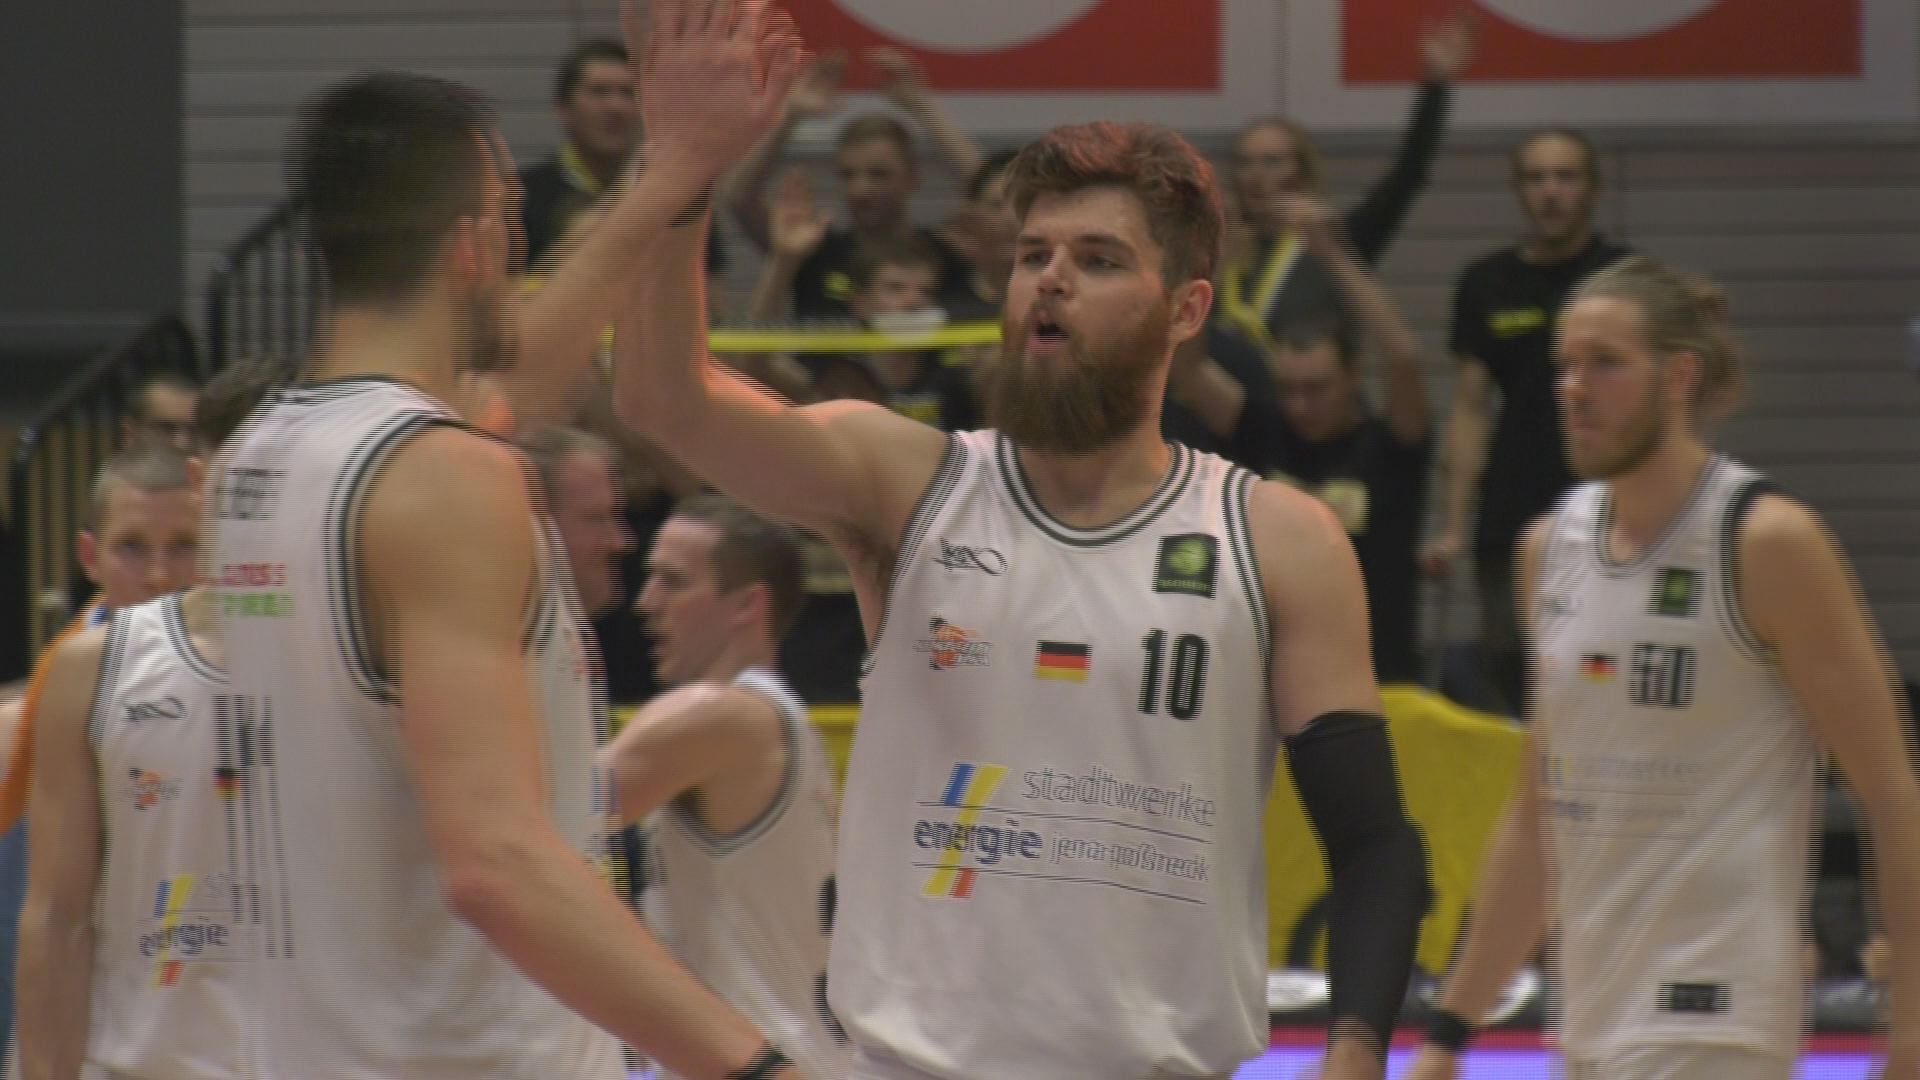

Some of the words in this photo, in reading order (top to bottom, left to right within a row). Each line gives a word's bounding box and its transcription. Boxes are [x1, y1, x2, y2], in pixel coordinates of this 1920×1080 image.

[1138, 628, 1210, 721] 10
[1628, 641, 1698, 711] 50
[1021, 764, 1216, 827] stadtwerke
[913, 817, 1044, 864] energie
[1049, 833, 1210, 881] jena-poßneck
